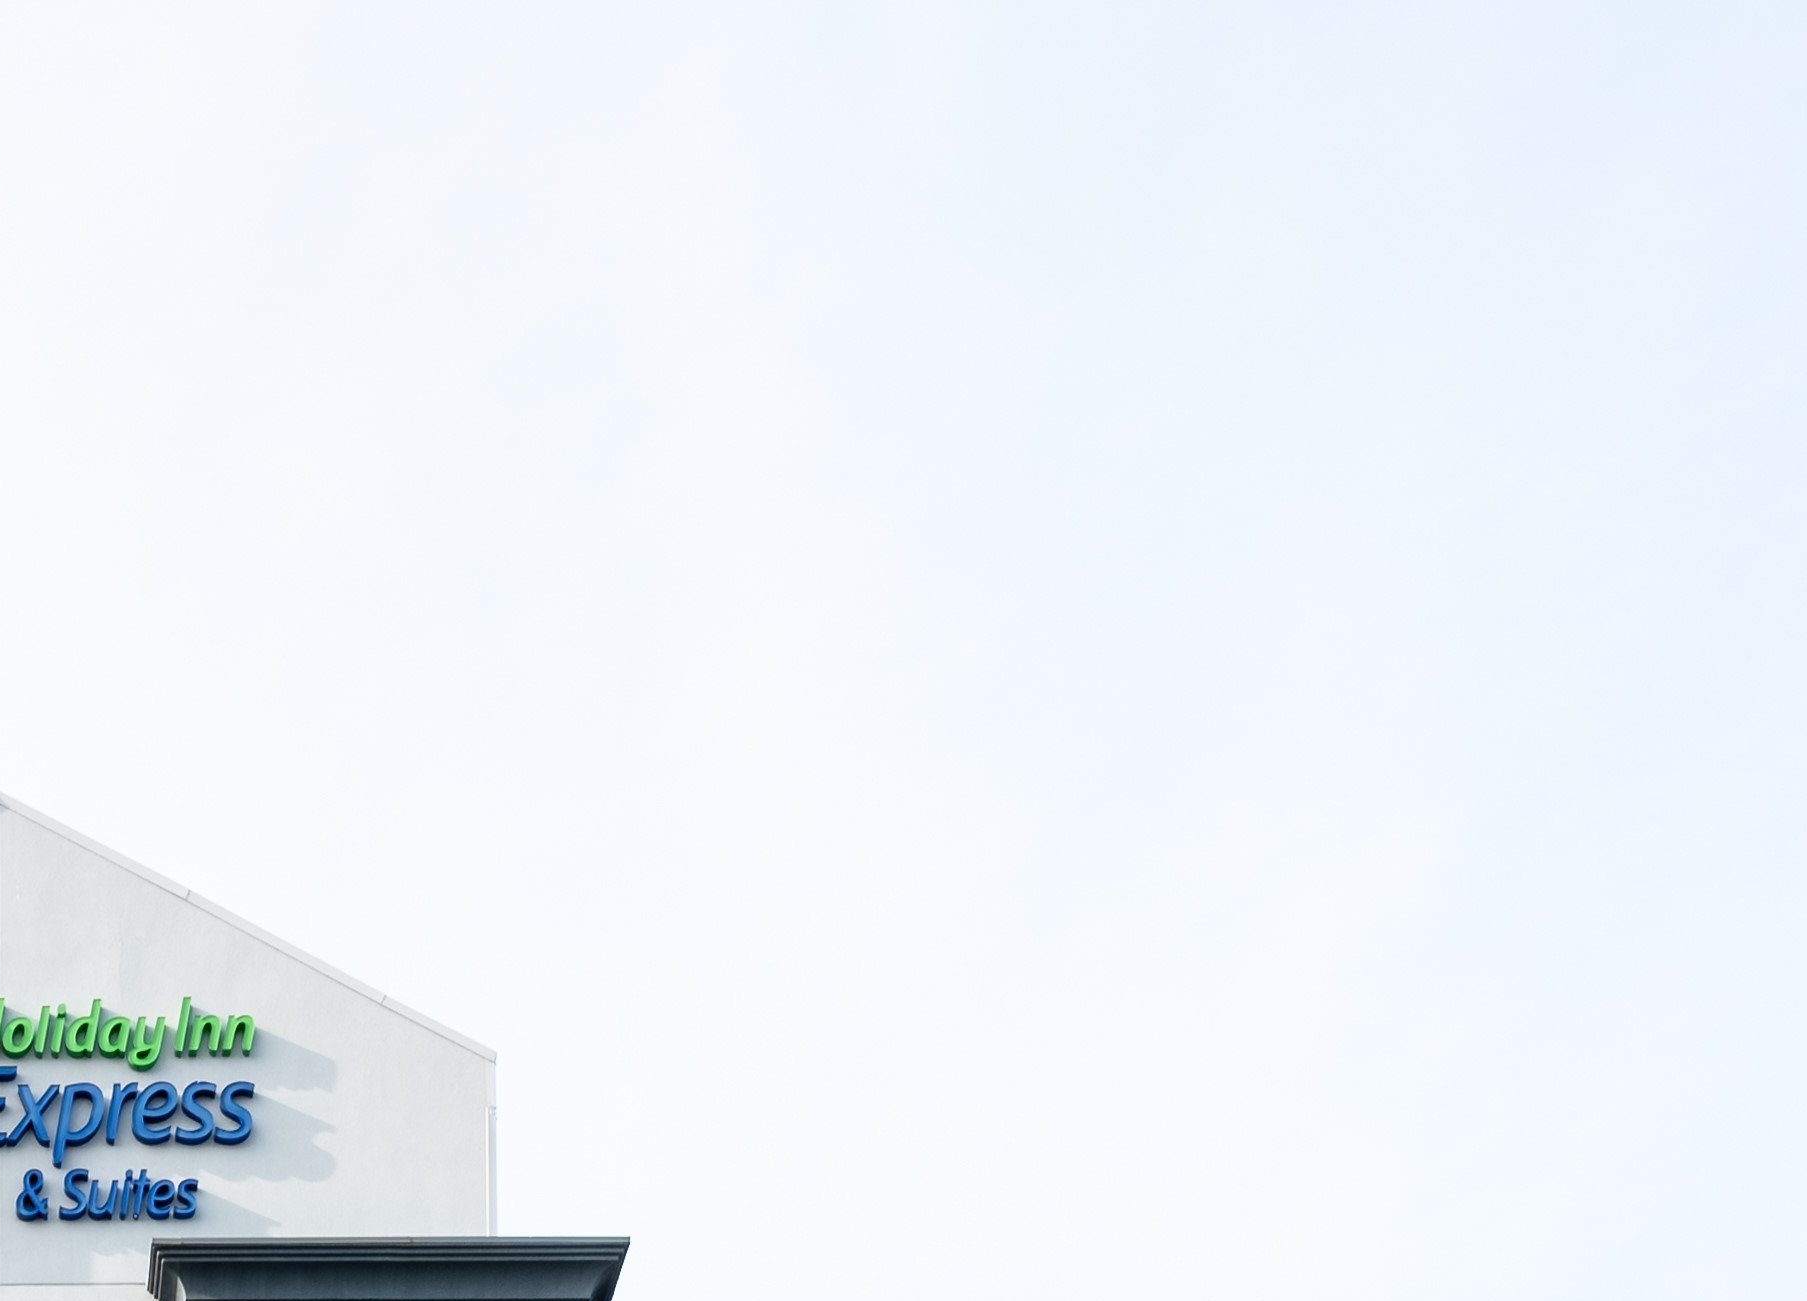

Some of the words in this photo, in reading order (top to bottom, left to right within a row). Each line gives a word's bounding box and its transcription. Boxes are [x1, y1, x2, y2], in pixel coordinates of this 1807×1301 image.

[174, 996, 257, 1058] Inn
[16, 1168, 49, 1221] &
[58, 1168, 199, 1222] Suites
